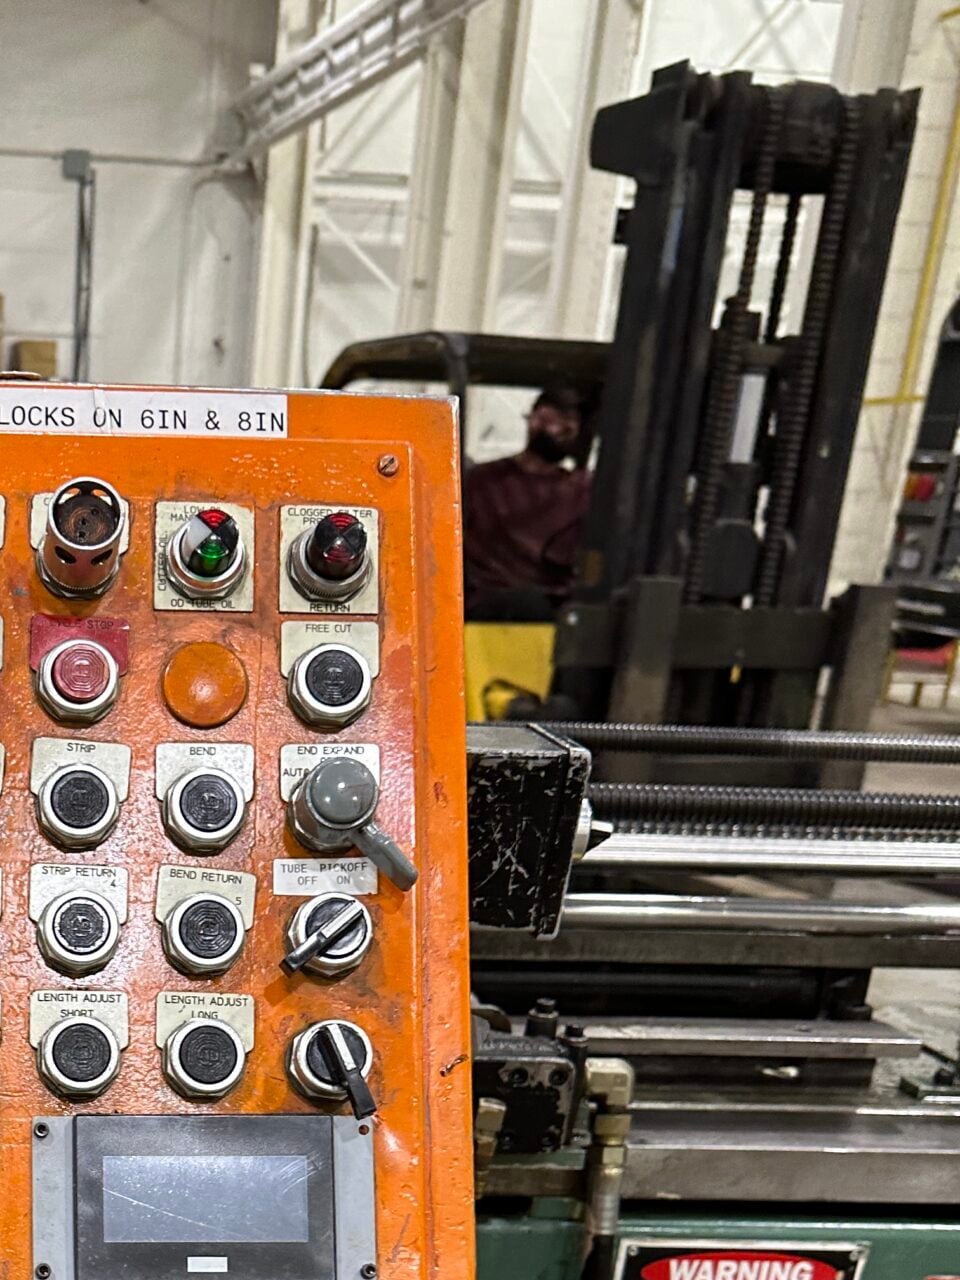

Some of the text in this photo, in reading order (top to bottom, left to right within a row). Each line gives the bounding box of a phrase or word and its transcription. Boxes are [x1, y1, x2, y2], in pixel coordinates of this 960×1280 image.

[93, 407, 122, 428] ON
[140, 409, 187, 429] 6IN
[205, 410, 220, 430] &
[238, 411, 284, 432] 8IN
[221, 600, 236, 609] OIL
[309, 602, 351, 613] RETURN
[86, 619, 114, 630] STOP
[305, 623, 352, 633] FREE CUT
[66, 742, 96, 753] STRIP
[189, 746, 217, 756] BEND
[297, 746, 365, 755] END EXPAND
[42, 866, 117, 878] STRIP RETURN
[280, 861, 369, 873] TUBE PICKOFF
[170, 869, 243, 885] BEND RETURN
[297, 875, 351, 886] OFF ON
[110, 879, 117, 888] 4
[37, 993, 122, 1003] LENGTH ADJUST
[164, 995, 249, 1007] LENGTH ADJUST
